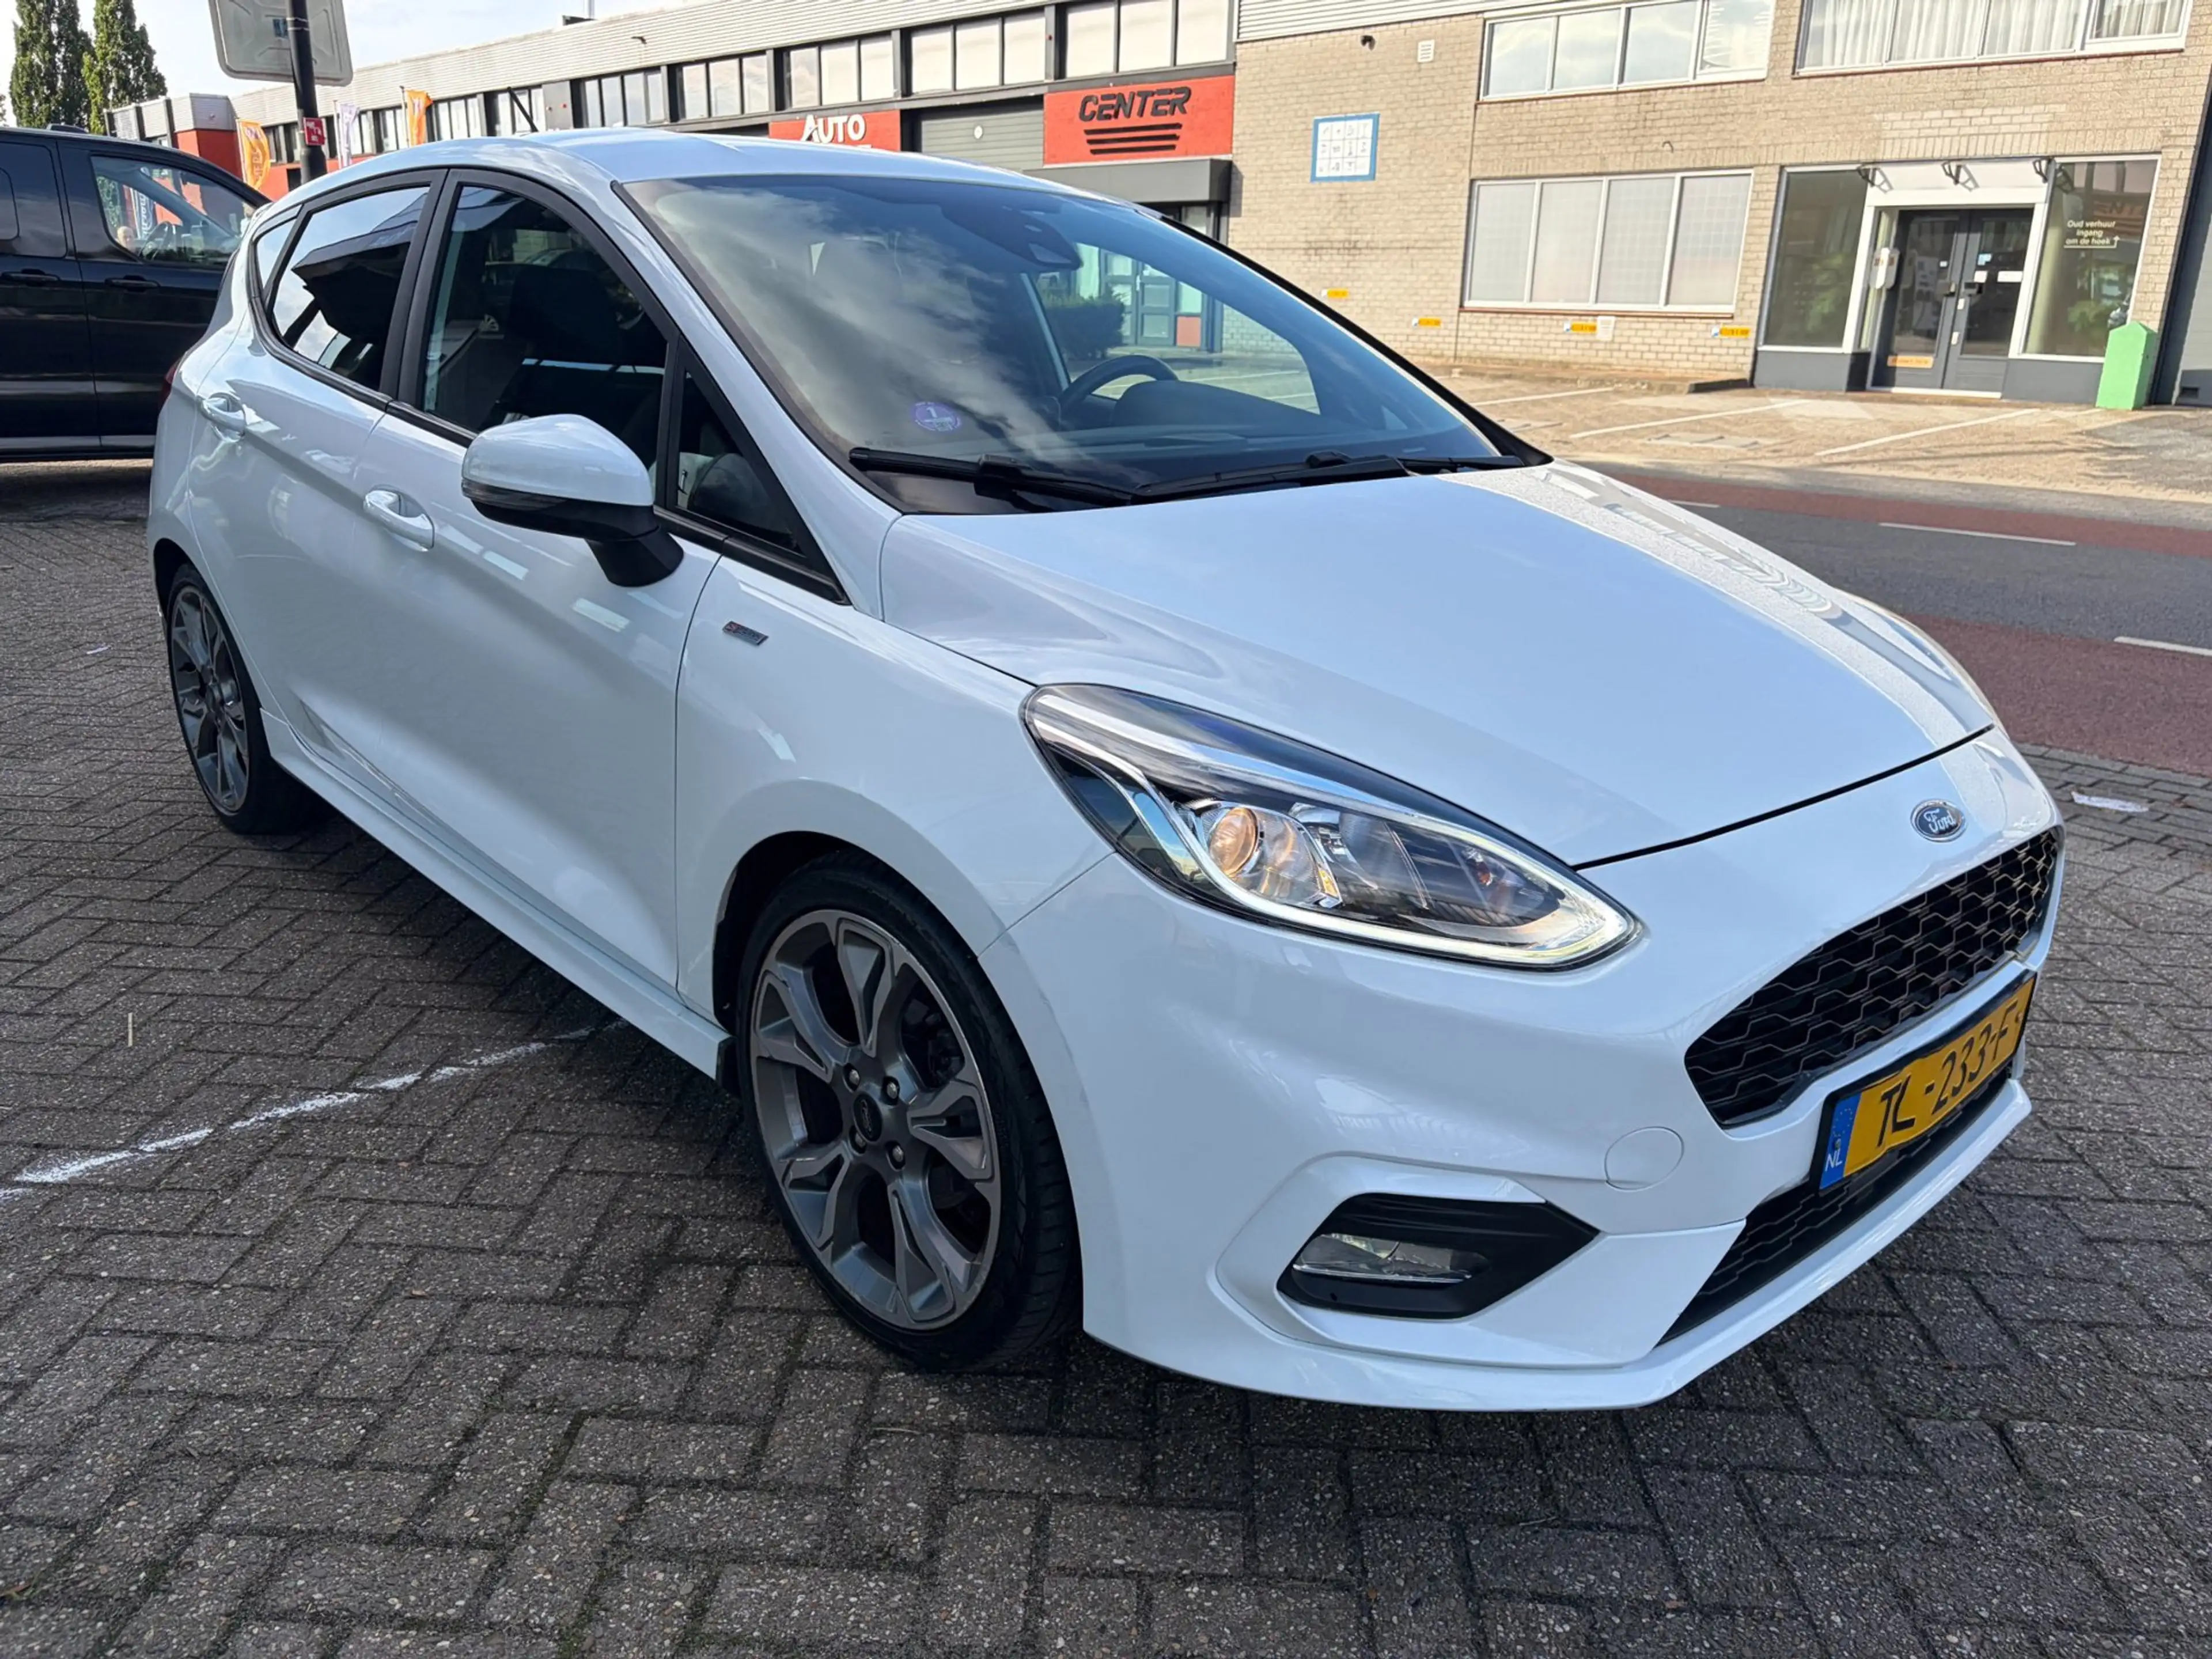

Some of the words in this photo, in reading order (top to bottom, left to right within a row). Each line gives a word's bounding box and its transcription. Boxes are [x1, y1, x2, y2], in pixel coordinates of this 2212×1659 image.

[1079, 86, 1191, 122] CENTER
[800, 114, 866, 143] AUTO
[1923, 808, 1957, 833] Ford
[1824, 1147, 1843, 1172] NL
[1876, 999, 2019, 1148] TL-233-F
